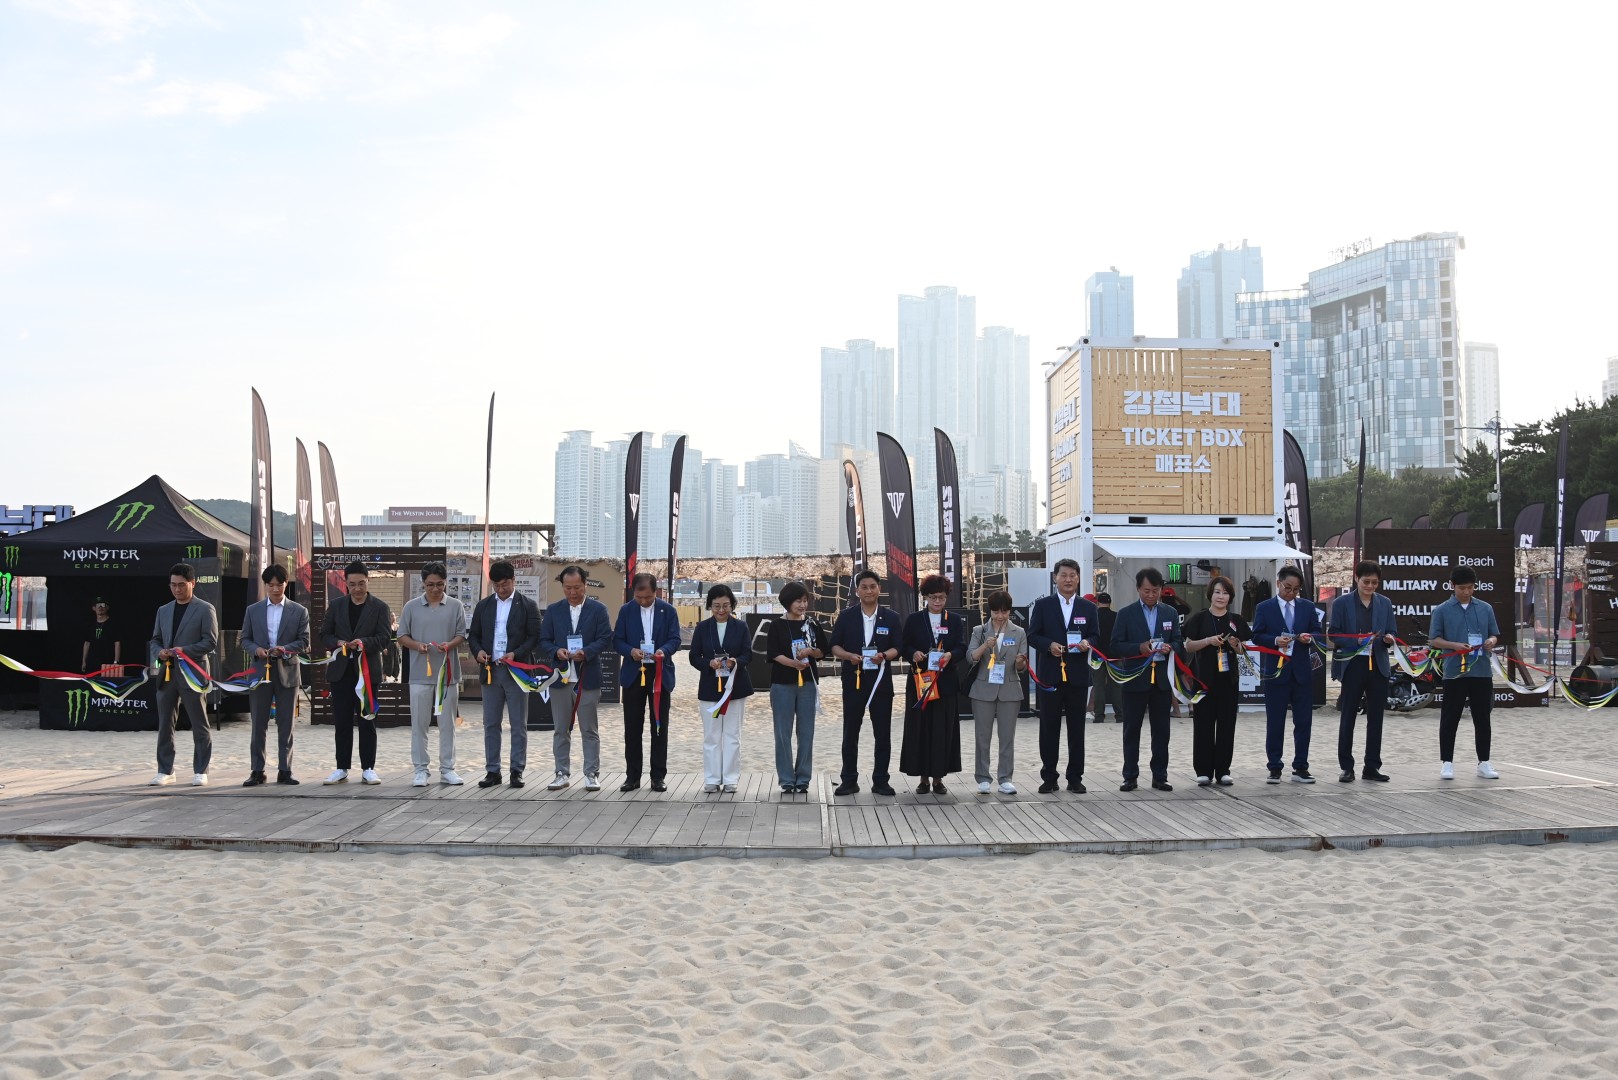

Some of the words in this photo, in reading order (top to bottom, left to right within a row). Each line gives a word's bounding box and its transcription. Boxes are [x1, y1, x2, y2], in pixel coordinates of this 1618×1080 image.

[1123, 390, 1241, 417] 강철부대
[1121, 427, 1196, 447] TICKET
[1200, 428, 1244, 447] BOX
[1155, 454, 1212, 473] 매표소
[63, 547, 140, 561] MONSTER
[1378, 555, 1448, 567] HAEUNDAE
[1458, 556, 1494, 567] Beach
[1383, 580, 1437, 591] MILITARY
[1442, 580, 1494, 592] obcles
[1392, 605, 1435, 616] CHALL
[91, 697, 148, 709] MONSTER
[1494, 693, 1515, 701] ROS
